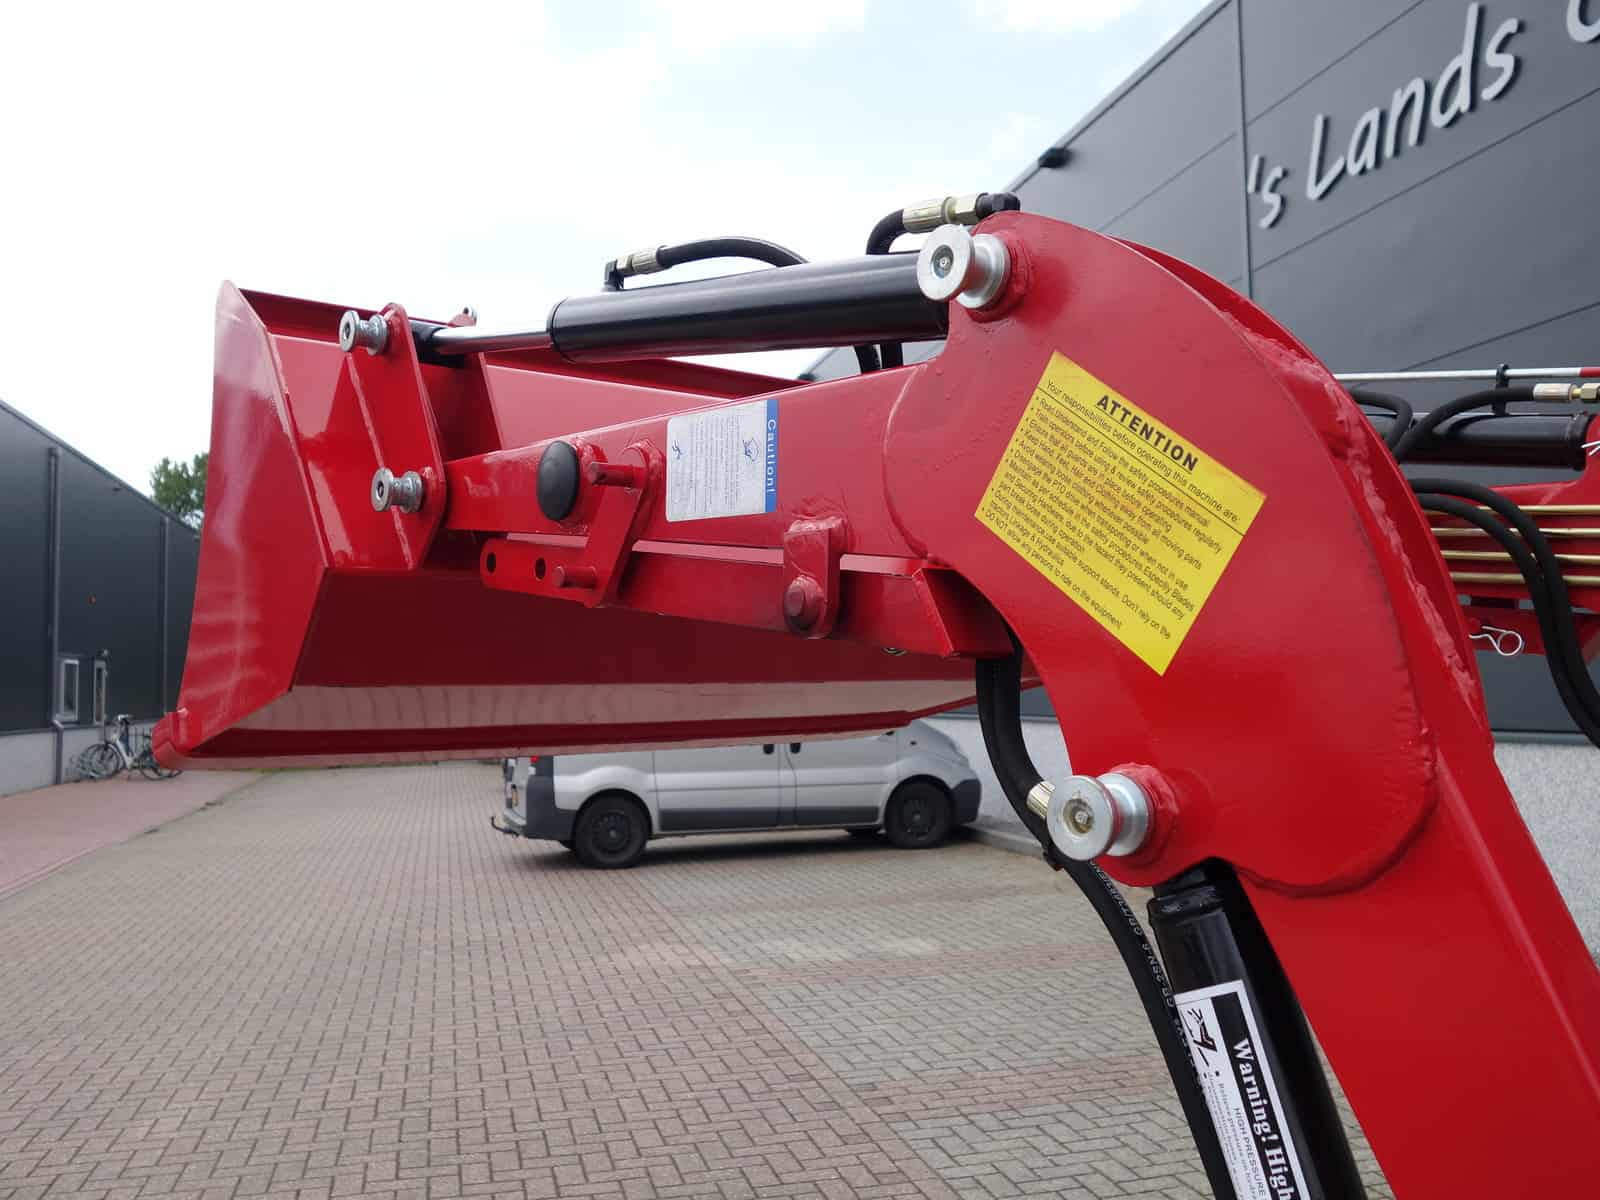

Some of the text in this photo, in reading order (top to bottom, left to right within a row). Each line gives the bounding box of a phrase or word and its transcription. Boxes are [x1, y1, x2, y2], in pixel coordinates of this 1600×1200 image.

[1248, 2, 1520, 230] 's Lands
[767, 419, 777, 493] Caution!
[1018, 439, 1036, 458] Avoid
[1071, 481, 1096, 505] clothing
[1028, 418, 1049, 439] Ensure
[1065, 449, 1089, 469] guards
[1087, 464, 1099, 477] are
[1097, 470, 1107, 482] in
[1102, 477, 1122, 495] place
[1120, 488, 1143, 510] before
[1141, 504, 1173, 534] operating
[1046, 378, 1064, 396] Your
[1061, 392, 1113, 433] responsibilities
[1111, 428, 1137, 451] before
[1136, 446, 1173, 478] operating
[1172, 470, 1188, 487] this
[1187, 483, 1223, 512] machine
[1085, 434, 1101, 448] and
[1097, 441, 1119, 461] Follow
[1117, 456, 1130, 469] the
[1128, 465, 1149, 486] safety
[1147, 479, 1185, 511] procedures
[1096, 394, 1199, 472] ATTENTION
[997, 480, 1012, 495] part
[1009, 488, 1027, 506] break
[1025, 499, 1042, 518] loose
[1040, 514, 1059, 535] during
[1006, 515, 1032, 538] Linkage
[1013, 448, 1043, 477] Disengage
[1041, 471, 1053, 485] the
[1050, 478, 1067, 495] PTO
[1064, 487, 1081, 507] drive
[1095, 514, 1133, 549] transporting
[1130, 543, 1141, 553] or
[1138, 548, 1158, 566] when
[1155, 562, 1170, 576] not
[1167, 570, 1176, 581] in
[1023, 428, 1040, 446] Keep
[1082, 475, 1097, 489] and
[1136, 514, 1153, 532] from
[1159, 534, 1185, 559] moving
[1031, 478, 1040, 489] as
[1037, 484, 1051, 496] per
[1048, 492, 1075, 517] schedule
[1073, 511, 1082, 522] in
[1080, 516, 1092, 530] the
[1090, 525, 1110, 546] safety
[1048, 420, 1075, 445] operators
[1074, 438, 1095, 459] before
[1092, 453, 1112, 473] using
[1109, 464, 1117, 475] &
[1115, 470, 1138, 490] review
[1136, 485, 1157, 506] safety
[1154, 500, 1193, 532] procedures
[1192, 527, 1223, 555] regularly
[984, 508, 996, 522] DO
[994, 516, 1009, 532] NOT
[1020, 541, 1033, 555] any
[1030, 549, 1055, 572] persons
[1053, 567, 1062, 578] to
[1071, 583, 1081, 594] on
[1079, 589, 1091, 603] the
[993, 489, 1013, 511] During
[1055, 541, 1079, 564] suitable
[1076, 559, 1101, 582] support
[1120, 593, 1140, 614] Don't
[1137, 608, 1151, 624] rely
[1149, 619, 1161, 631] on
[1159, 625, 1172, 640] the
[1003, 471, 1017, 484] and
[1013, 477, 1039, 505] Securing
[1064, 519, 1078, 533] due
[1076, 527, 1084, 539] to
[1082, 533, 1095, 547] the
[1092, 541, 1116, 564] hazard
[1113, 558, 1129, 575] they
[1126, 569, 1152, 593] present
[1149, 588, 1174, 610] should
[1170, 606, 1186, 621] any
[1233, 1038, 1295, 1200] Warning! High
[1233, 1107, 1267, 1196] HIGH PRESSURE
